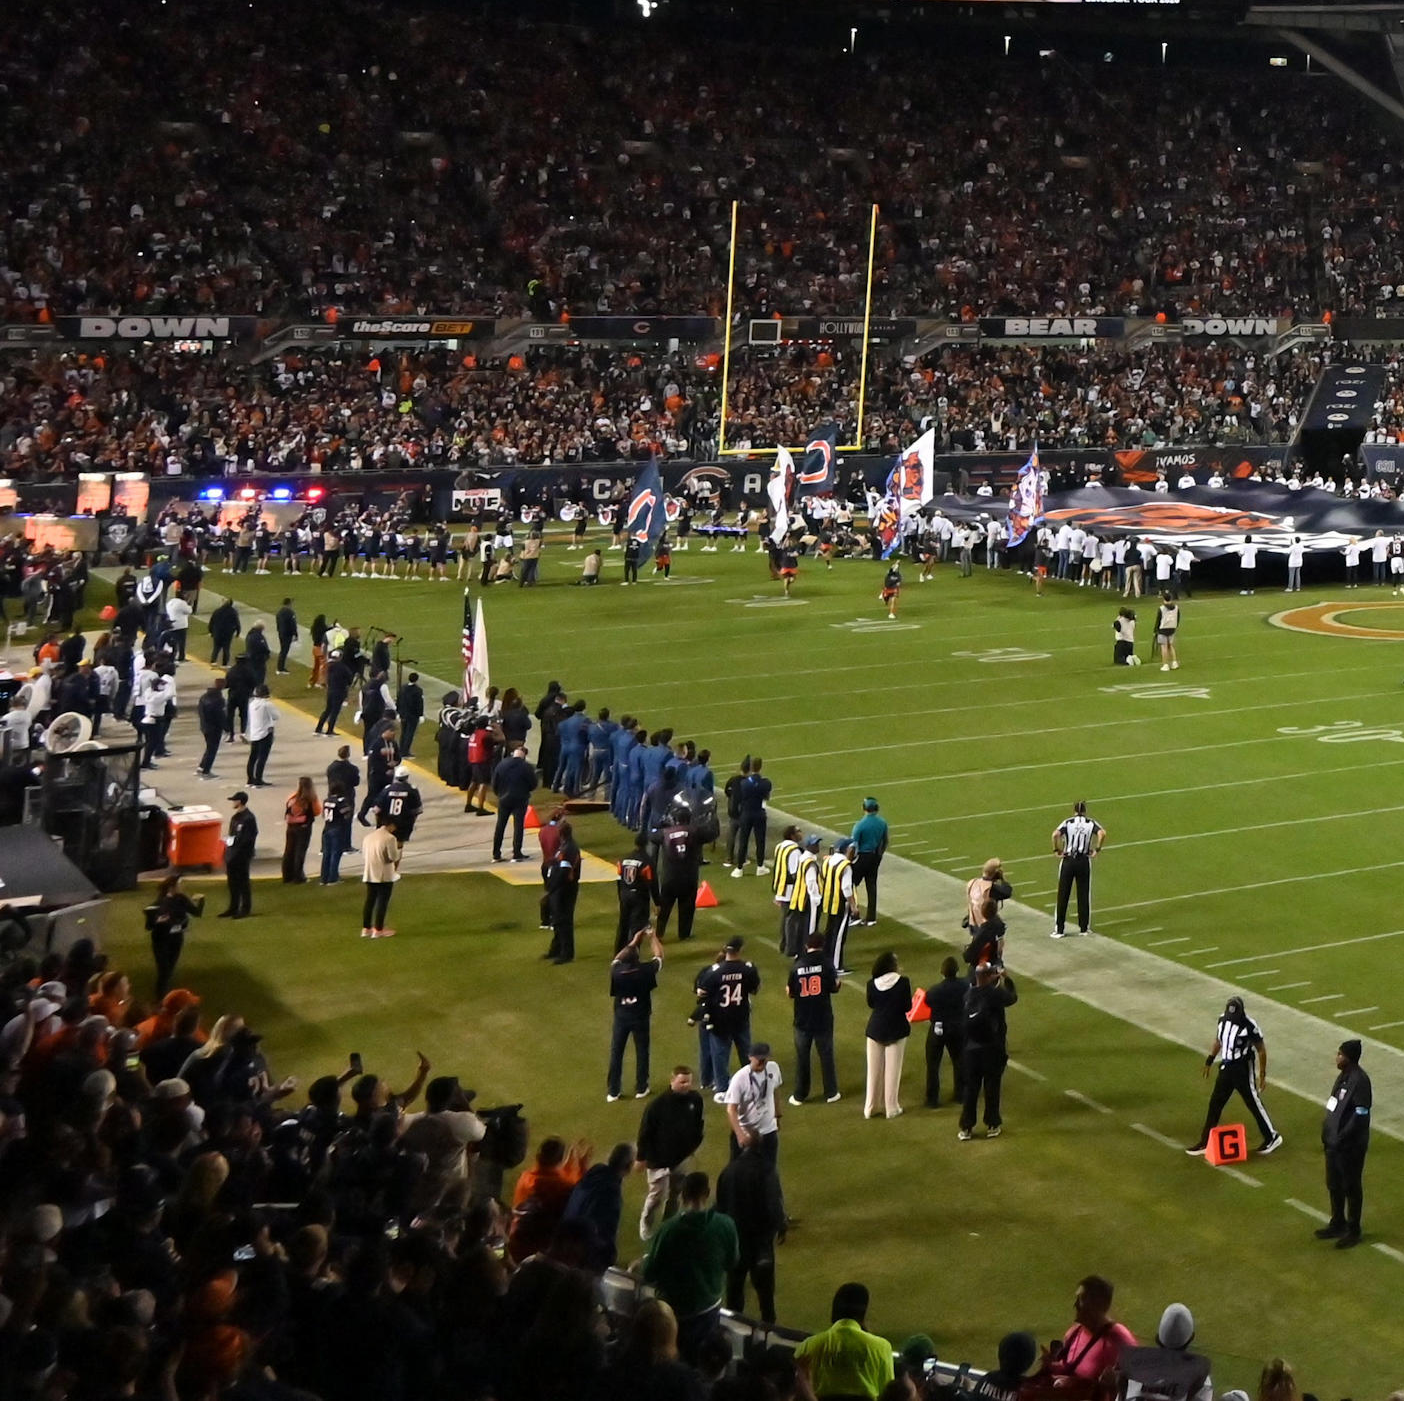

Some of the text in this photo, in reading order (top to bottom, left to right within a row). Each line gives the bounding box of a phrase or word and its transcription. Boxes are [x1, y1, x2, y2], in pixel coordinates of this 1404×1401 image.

[80, 318, 229, 337] DOWN
[353, 321, 471, 334] theScore BET
[1005, 318, 1097, 336] BEAR
[1183, 319, 1278, 336] DOWN
[389, 798, 404, 816] 18
[798, 975, 823, 997] 18
[719, 983, 743, 1008] 34
[1218, 1130, 1240, 1160] G
